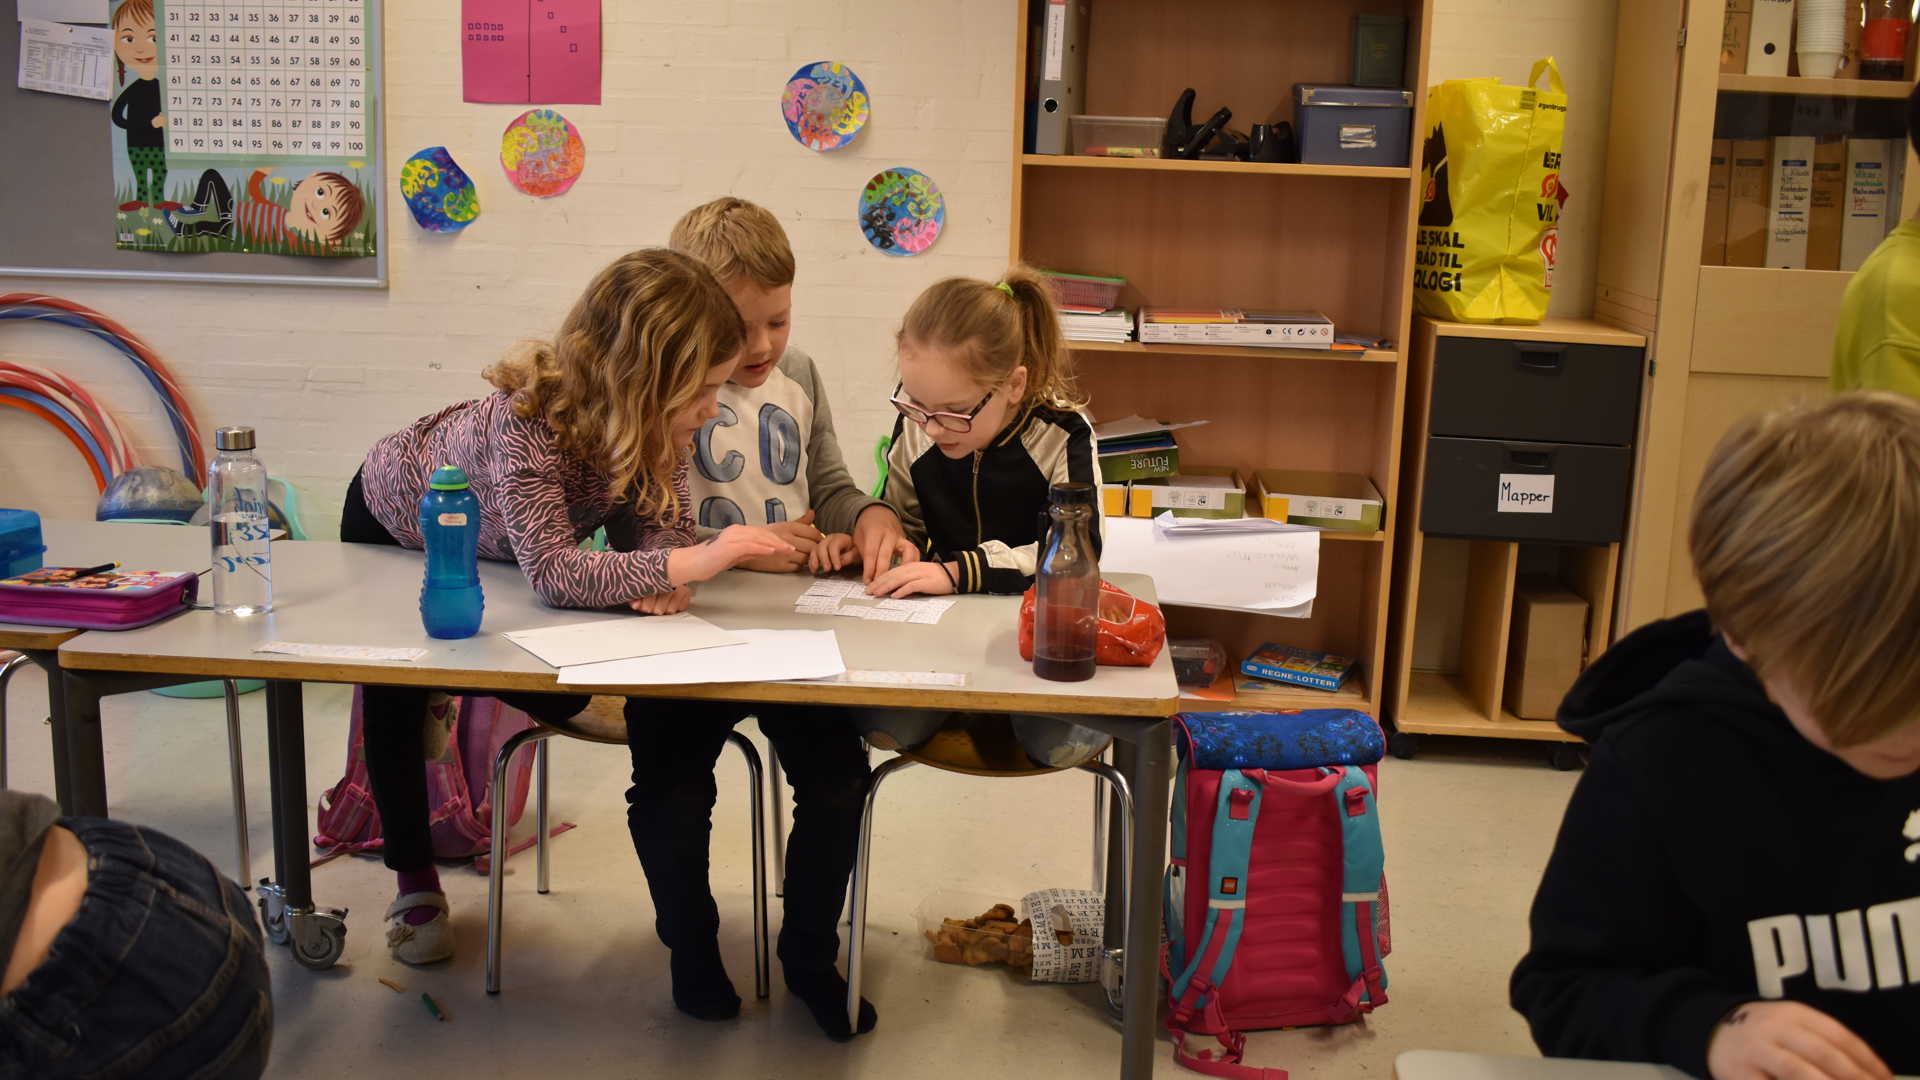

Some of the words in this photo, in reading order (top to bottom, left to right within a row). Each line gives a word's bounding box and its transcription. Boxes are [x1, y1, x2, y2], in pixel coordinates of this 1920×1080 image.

[170, 12, 180, 22] 31
[189, 13, 200, 22] 32
[209, 13, 220, 23] 33
[229, 13, 240, 23] 34
[249, 13, 260, 23] 35
[269, 14, 280, 23] 36
[289, 14, 300, 23] 37
[309, 14, 320, 24] 38
[329, 15, 340, 24] 39
[349, 15, 360, 24] 40
[170, 34, 180, 43] 41
[190, 34, 201, 43] 42
[209, 34, 221, 44] 43
[229, 35, 240, 43] 44
[249, 35, 261, 44] 45
[269, 35, 281, 44] 46
[289, 35, 300, 44] 47
[309, 36, 320, 45] 48
[329, 36, 341, 45] 49
[349, 36, 361, 46] 50
[171, 55, 181, 64] 51
[191, 55, 202, 65] 52
[211, 55, 222, 65] 53
[231, 56, 241, 65] 54
[251, 56, 261, 66] 55
[270, 56, 281, 66] 56
[290, 57, 301, 66] 57
[309, 57, 321, 67] 58
[330, 57, 341, 67] 59
[349, 58, 361, 67] 60
[171, 76, 182, 85] 61
[191, 76, 202, 85] 62
[211, 76, 223, 86] 63
[230, 77, 242, 86] 64
[250, 77, 262, 87] 65
[270, 78, 281, 87] 66
[290, 78, 301, 87] 67
[310, 78, 321, 88] 68
[330, 78, 342, 88] 69
[350, 79, 361, 88] 70
[172, 97, 183, 105] 71
[192, 97, 203, 106] 72
[212, 97, 223, 107] 73
[232, 98, 243, 107] 74
[251, 98, 262, 107] 75
[271, 98, 282, 108] 76
[291, 99, 302, 108] 77
[312, 99, 322, 108] 78
[331, 100, 342, 108] 79
[350, 100, 361, 109] 80
[173, 118, 183, 127] 81
[193, 118, 204, 127] 82
[212, 118, 224, 128] 83
[232, 119, 243, 128] 84
[251, 119, 263, 128] 85
[272, 120, 283, 129] 86
[292, 120, 303, 129] 87
[312, 120, 323, 130] 88
[331, 121, 342, 130] 89
[349, 121, 361, 130] 90
[174, 138, 184, 147] 91
[193, 139, 205, 148] 92
[213, 139, 224, 148] 93
[232, 140, 244, 148] 94
[252, 140, 263, 149] 95
[272, 140, 284, 150] 96
[292, 141, 303, 149] 97
[312, 141, 322, 151] 98
[330, 142, 341, 150] 99
[348, 142, 364, 151] 100
[1428, 231, 1465, 249] SKAL
[1439, 252, 1463, 269] TIL
[1130, 456, 1169, 470] FUTURE
[1501, 482, 1551, 506] Mapper
